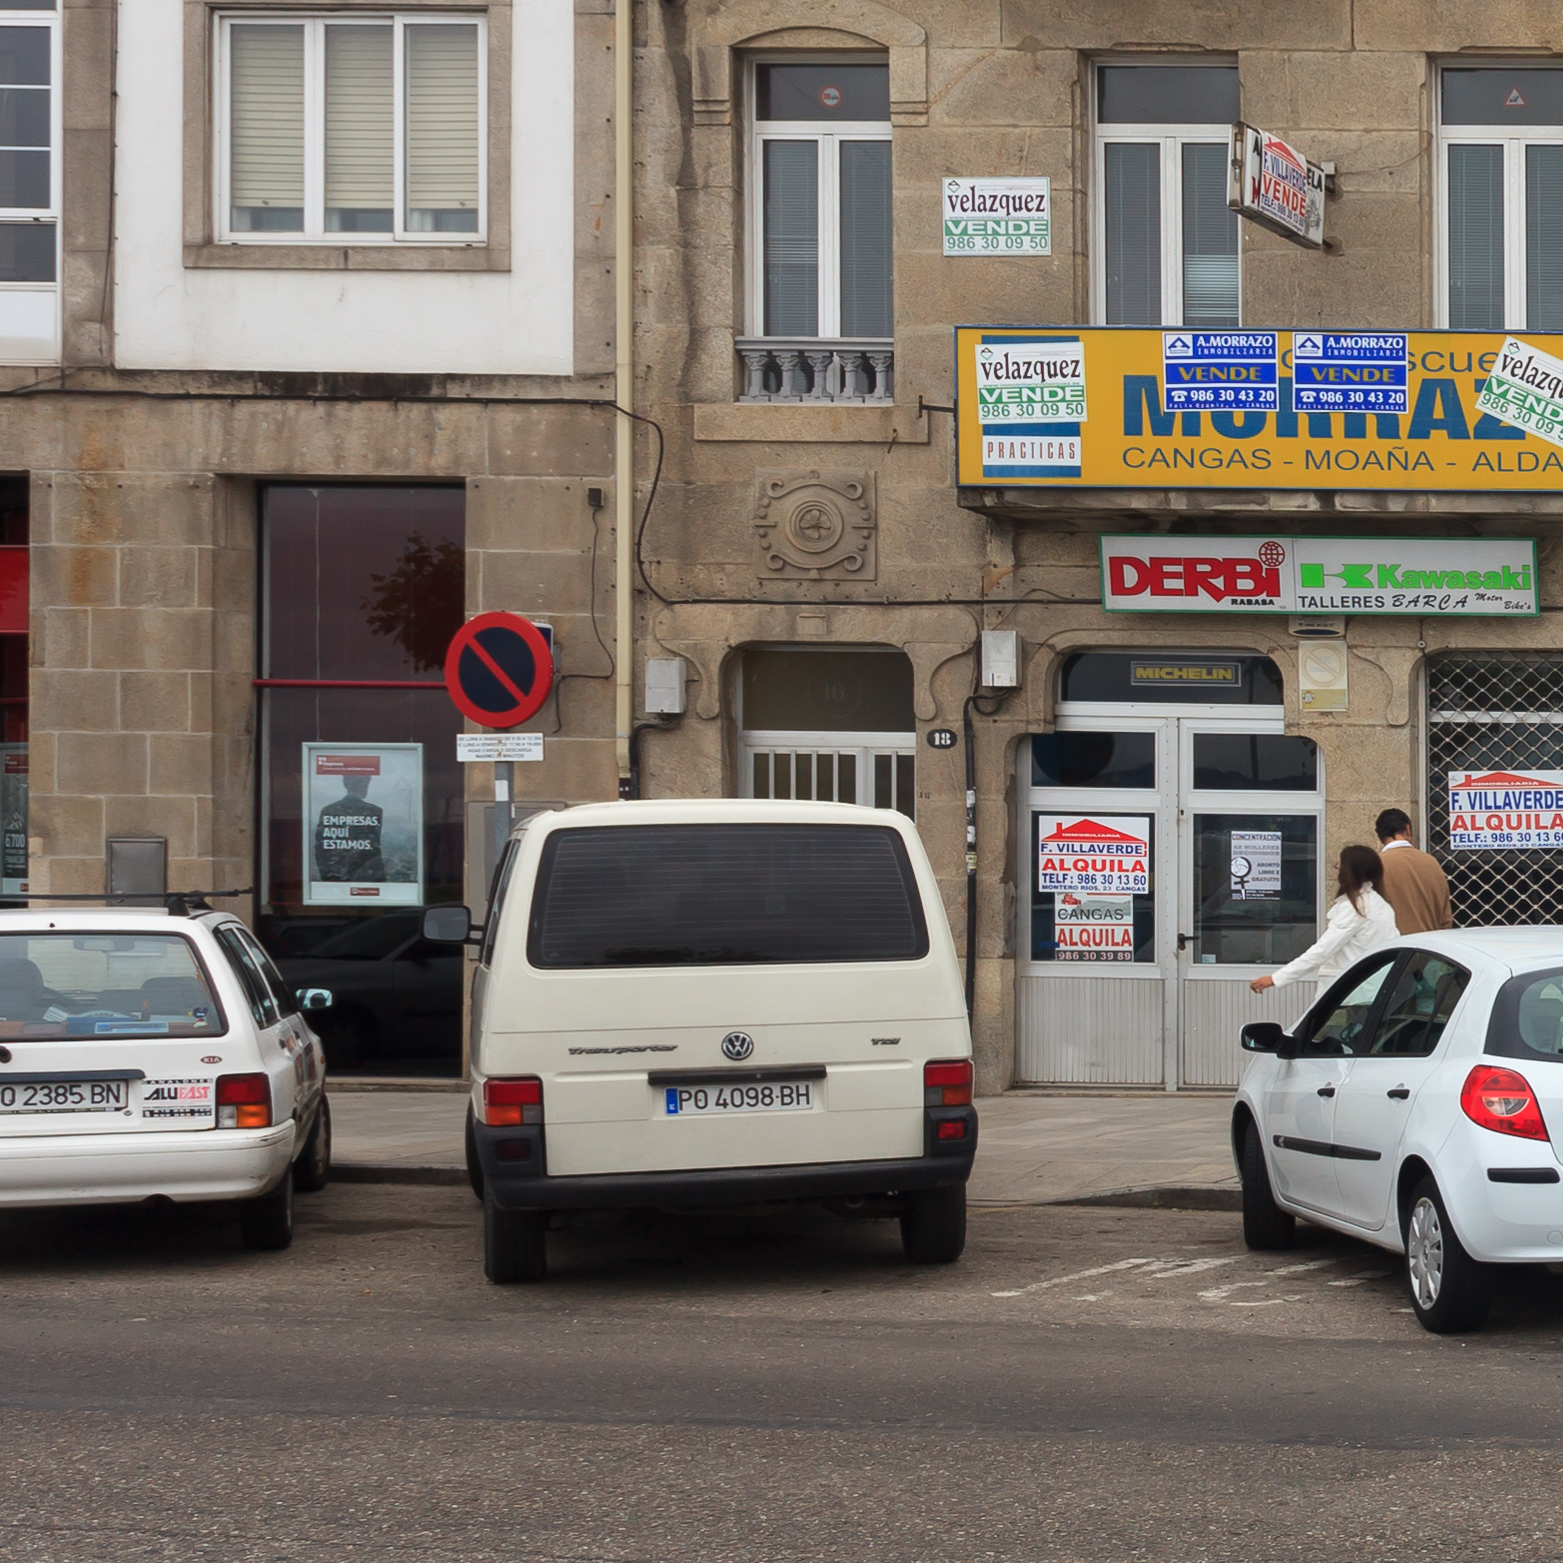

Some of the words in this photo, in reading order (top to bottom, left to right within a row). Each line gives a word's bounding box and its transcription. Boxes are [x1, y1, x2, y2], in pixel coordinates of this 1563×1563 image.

[947, 185, 1045, 216] velazquez
[946, 221, 1048, 234] VENDE
[947, 237, 975, 249] 986
[981, 237, 999, 249] 30
[1005, 237, 1023, 249] 09
[1030, 237, 1047, 249] 50
[1197, 336, 1272, 347] A.MORRAZO
[1327, 337, 1403, 348] A.MORRAZO
[981, 352, 1080, 382] velazquez
[1178, 367, 1262, 380] VENDE
[1311, 368, 1395, 382] VENDE
[981, 387, 1084, 402] VENDE
[1190, 390, 1214, 401] 986
[1219, 390, 1234, 401] 30
[1238, 390, 1254, 401] 43
[1259, 390, 1274, 401] 20
[988, 442, 1075, 459] PRACTICAS
[1122, 446, 1272, 470] CANGAS
[1305, 446, 1435, 471] MOAÑA
[1378, 563, 1531, 591] Kawasaki
[1299, 595, 1385, 609] TALLERES
[1392, 594, 1468, 610] BARCA
[1135, 667, 1234, 680] MICHELIN
[934, 733, 951, 746] 18
[1467, 791, 1563, 810] VILLAVERDE
[323, 826, 349, 839] AQUÍ
[1491, 833, 1512, 842] 986
[1517, 832, 1531, 842] 30
[1536, 832, 1549, 842] 13
[324, 840, 372, 849] ESTAMOS.
[1057, 844, 1143, 854] VILLAVERDE
[1042, 859, 1146, 873] ALQUILA
[1078, 874, 1097, 884] 986
[1101, 875, 1113, 885] 30
[1118, 875, 1130, 885] 13
[1134, 876, 1146, 885] 60
[1058, 909, 1124, 920] CANGAS
[1058, 929, 1132, 948] ALQUILA
[1059, 952, 1079, 960] 986
[1083, 952, 1096, 960] 30
[1101, 952, 1113, 960] 39
[1117, 952, 1130, 960] 89
[569, 1044, 679, 1055] Transporter
[23, 1085, 83, 1106] 2385
[91, 1084, 120, 1104] BN
[679, 1089, 708, 1111] PO
[715, 1087, 774, 1109] 4098
[781, 1085, 810, 1107] BH
